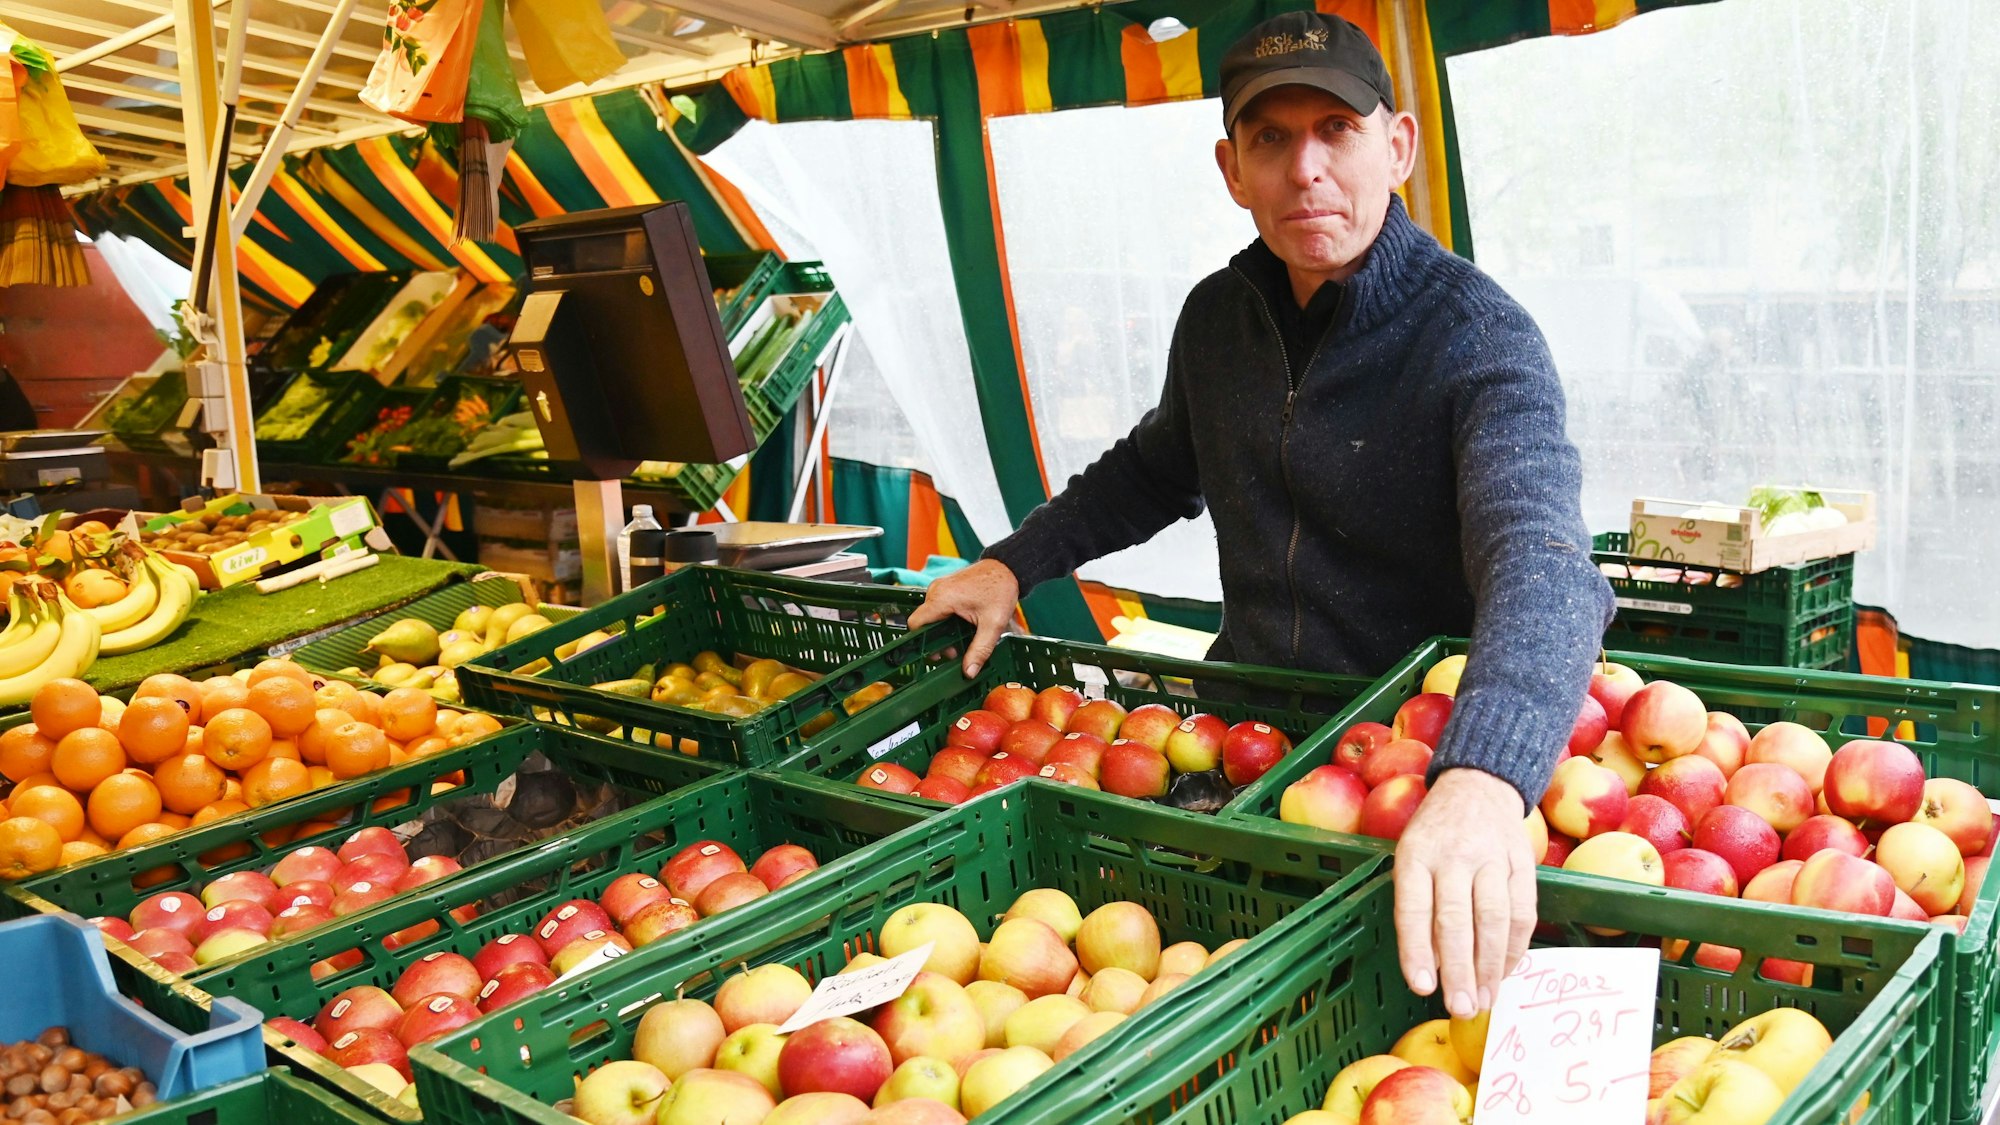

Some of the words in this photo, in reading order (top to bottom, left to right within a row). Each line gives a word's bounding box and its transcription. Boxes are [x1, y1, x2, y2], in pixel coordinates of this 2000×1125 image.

[1256, 39, 1327, 58] Wolfskin
[1260, 32, 1293, 48] Jack
[229, 547, 260, 571] kiwi
[1523, 968, 1612, 1005] Topaz
